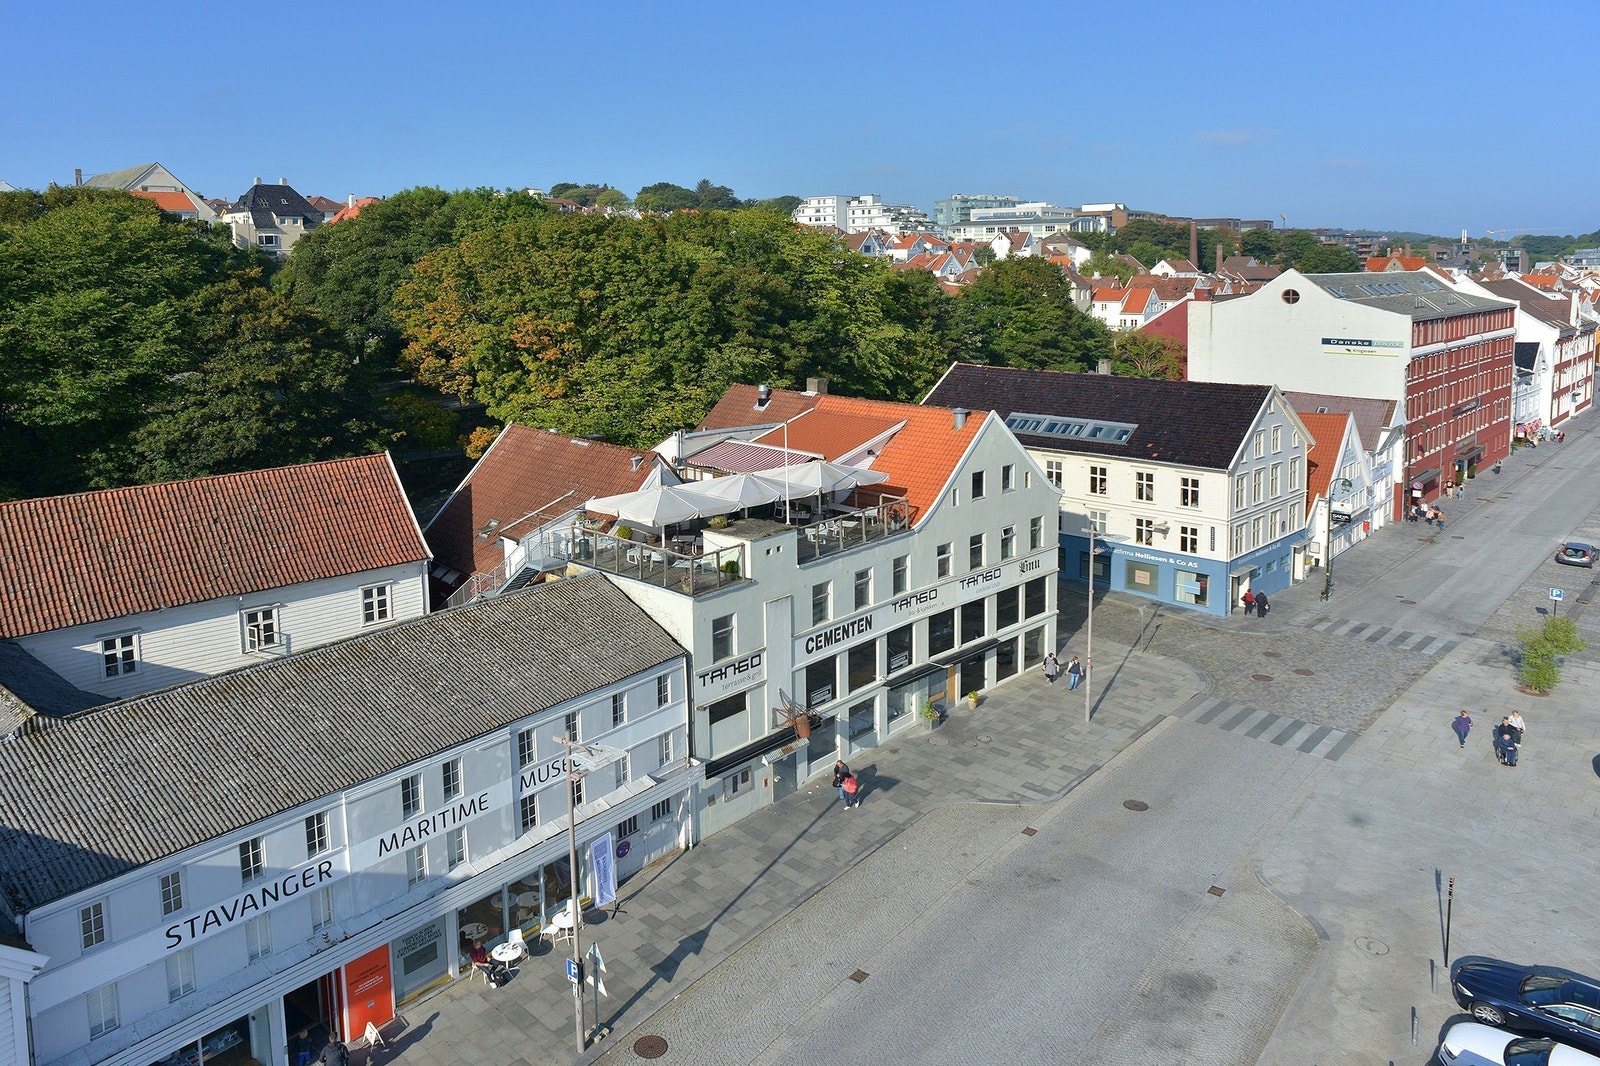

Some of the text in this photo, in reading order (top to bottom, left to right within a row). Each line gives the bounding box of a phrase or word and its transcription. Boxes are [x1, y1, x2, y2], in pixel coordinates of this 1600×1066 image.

[1134, 552, 1168, 562] Helliesen
[1176, 559, 1186, 567] Co
[960, 568, 1001, 590] TANGO
[892, 588, 937, 613] TANGO
[805, 614, 873, 654] CEMENTEN
[699, 654, 762, 687] TANGO
[166, 860, 333, 949] STAVANGER
[378, 792, 490, 857] MARITIME
[571, 963, 578, 976] P
